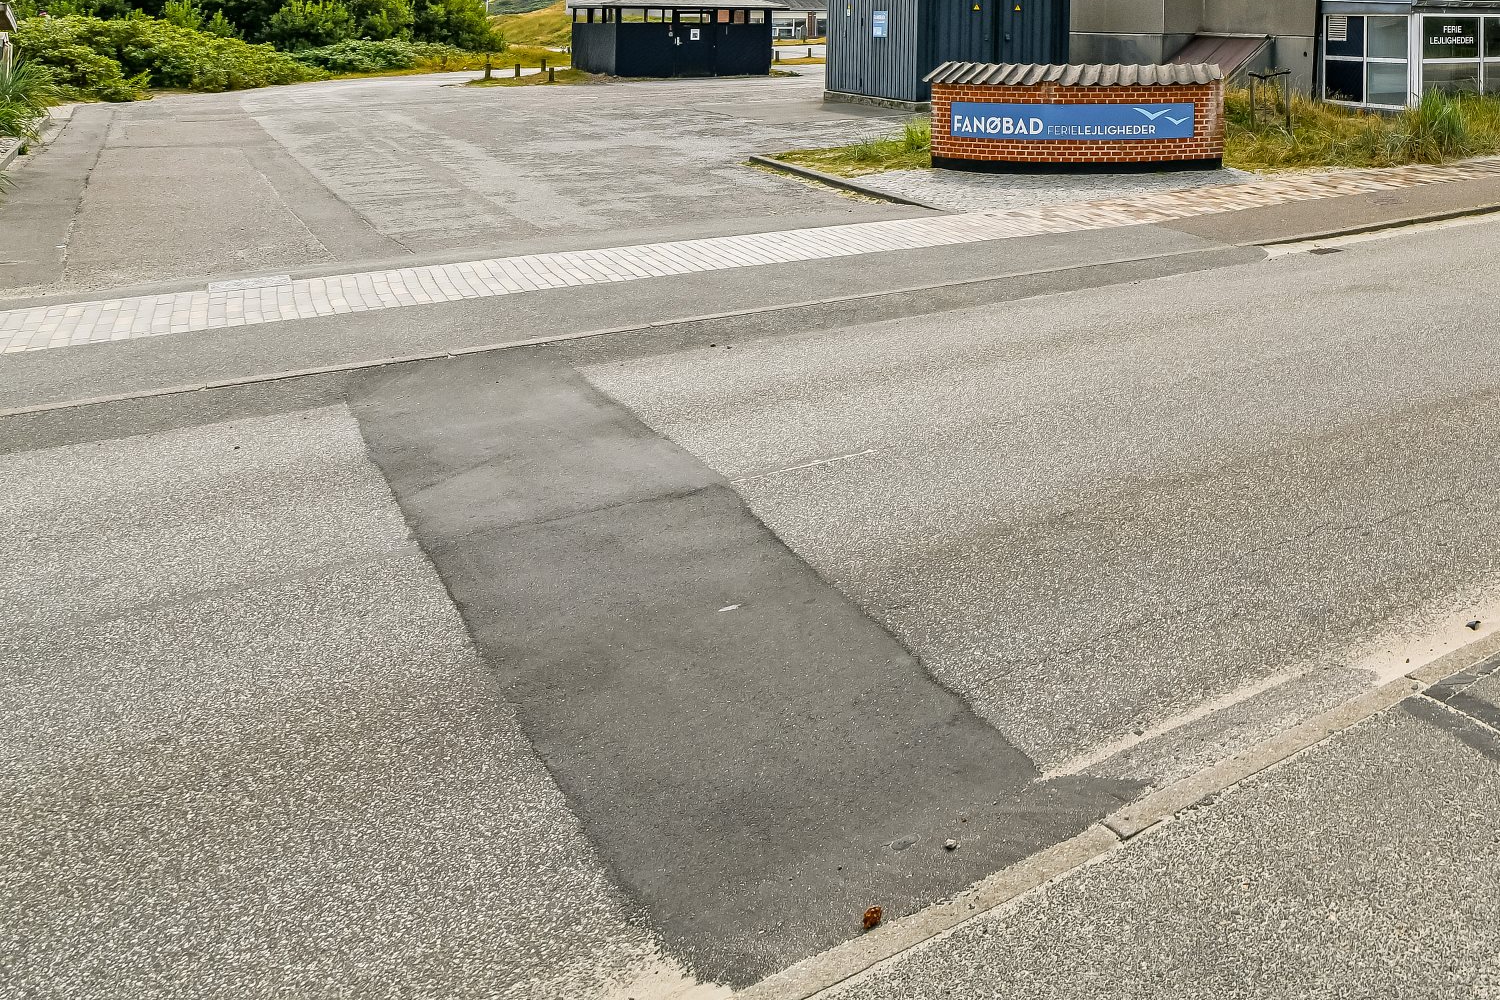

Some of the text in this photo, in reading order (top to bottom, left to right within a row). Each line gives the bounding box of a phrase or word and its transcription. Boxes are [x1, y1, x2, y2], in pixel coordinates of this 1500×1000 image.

[1443, 25, 1462, 33] FERIE
[1430, 36, 1474, 45] LEJLIGHEDER
[953, 115, 1156, 135] FANØBAD FERIELEJLIGHEDER
